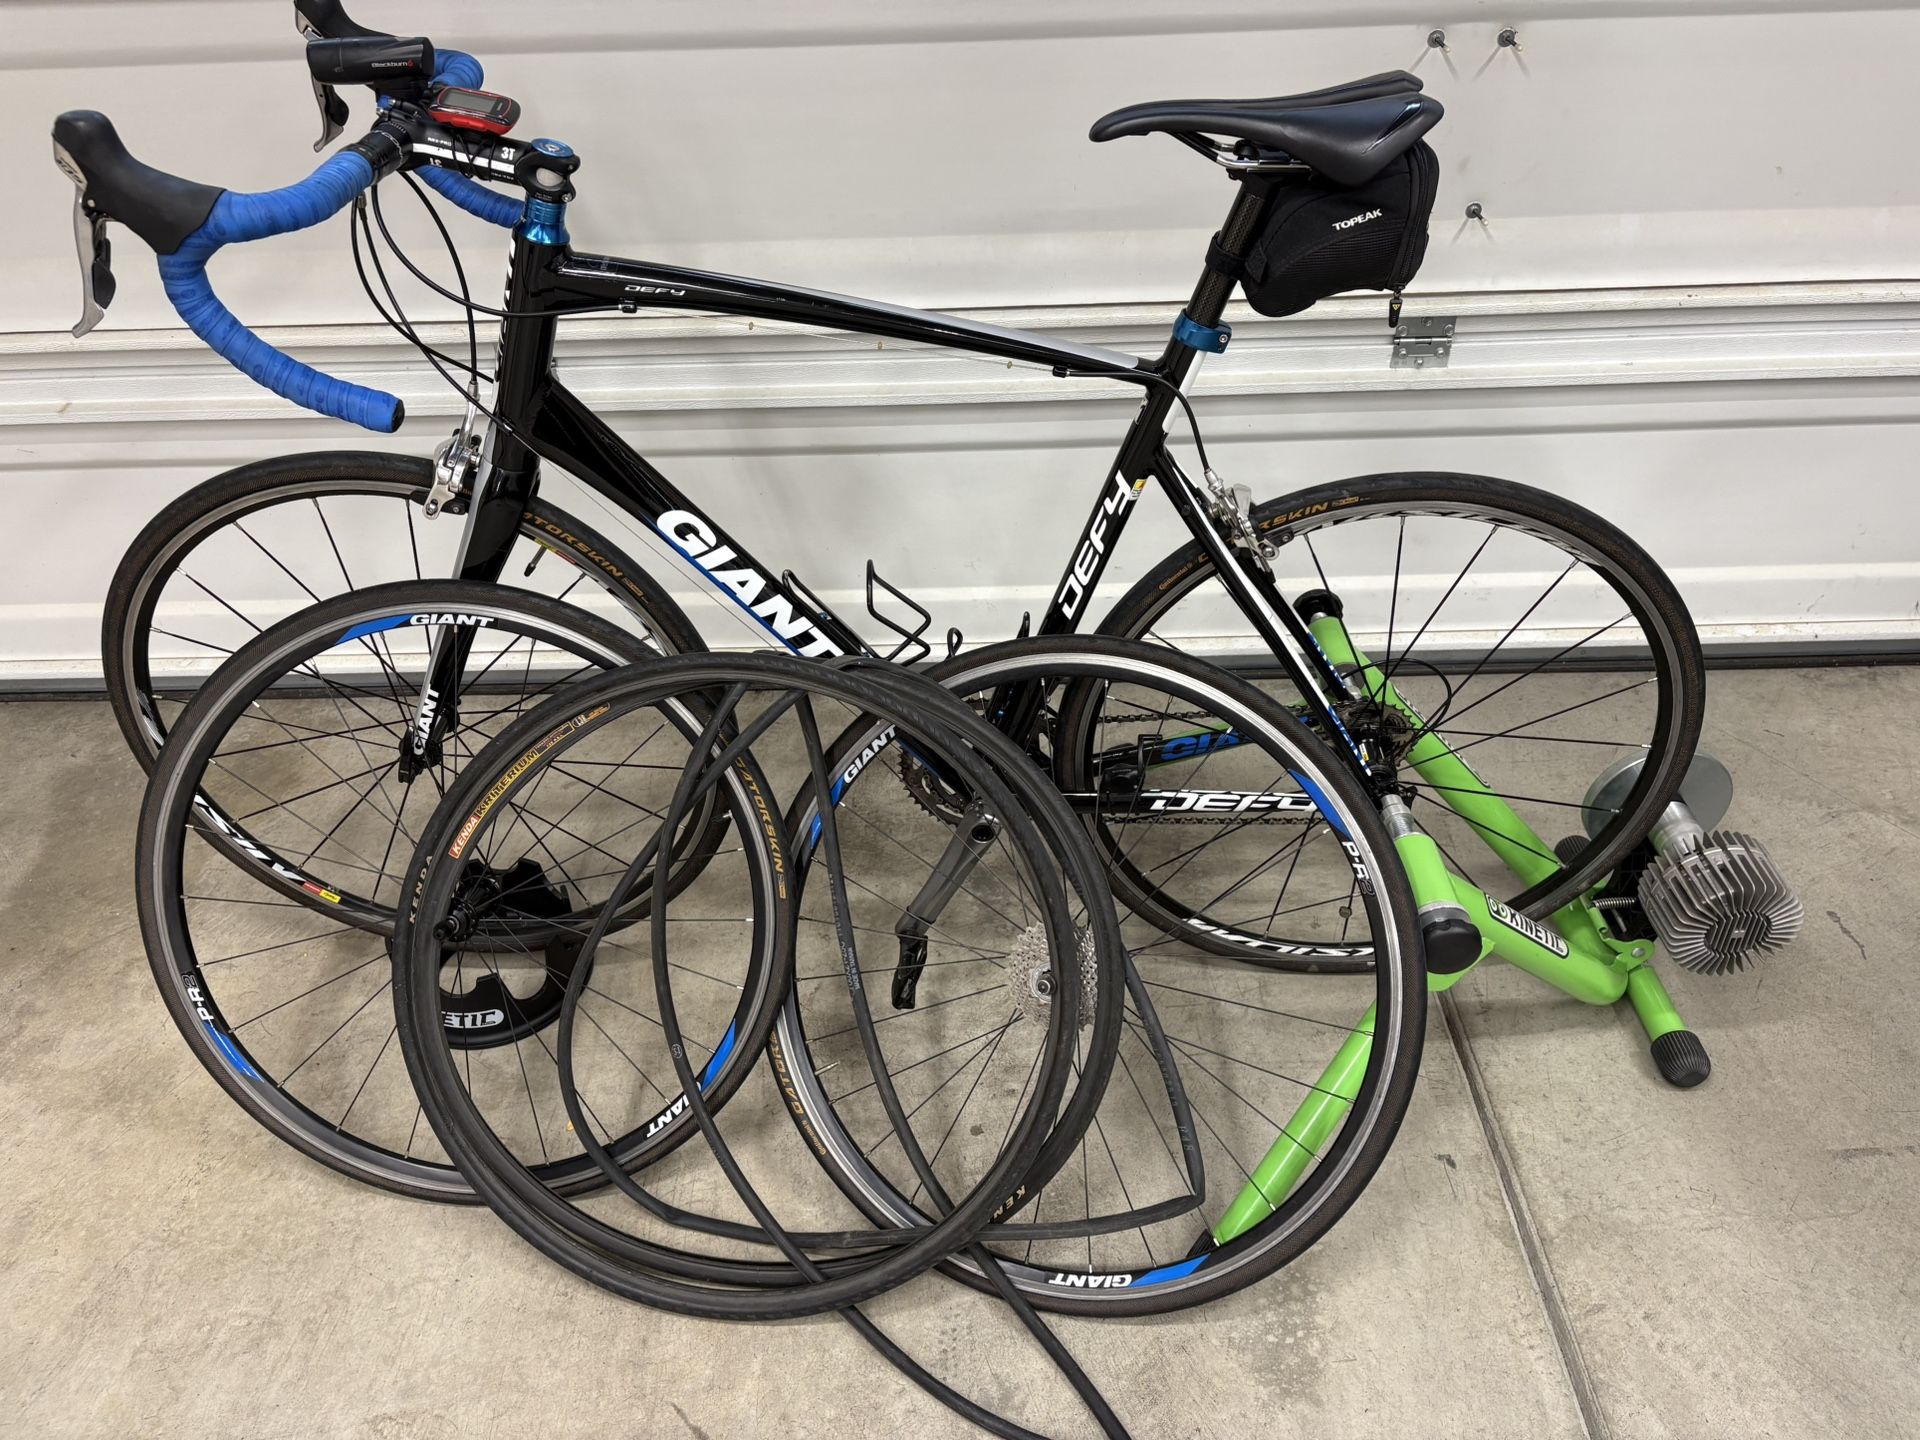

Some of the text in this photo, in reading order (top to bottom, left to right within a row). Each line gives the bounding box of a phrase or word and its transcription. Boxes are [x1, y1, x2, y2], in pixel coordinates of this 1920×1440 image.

[501, 146, 516, 160] 3T
[1331, 208, 1382, 231] TOPEAK
[624, 284, 686, 297] DEFY
[523, 512, 623, 577] TORSKIN
[1058, 469, 1132, 620] DEFY
[656, 509, 845, 657] GIANT
[410, 613, 495, 627] GIANT
[413, 684, 440, 755] GIANT
[843, 724, 896, 784] GIANT
[1161, 731, 1250, 760] GIA
[451, 750, 539, 856] KENDA KRITERIUM
[408, 855, 433, 926] KENDA
[1510, 911, 1562, 949] KINETIC
[441, 1011, 496, 1027] ETIC
[646, 1083, 702, 1139] IANT
[993, 1184, 1026, 1219] KEN
[1047, 1273, 1133, 1288] GIANT
